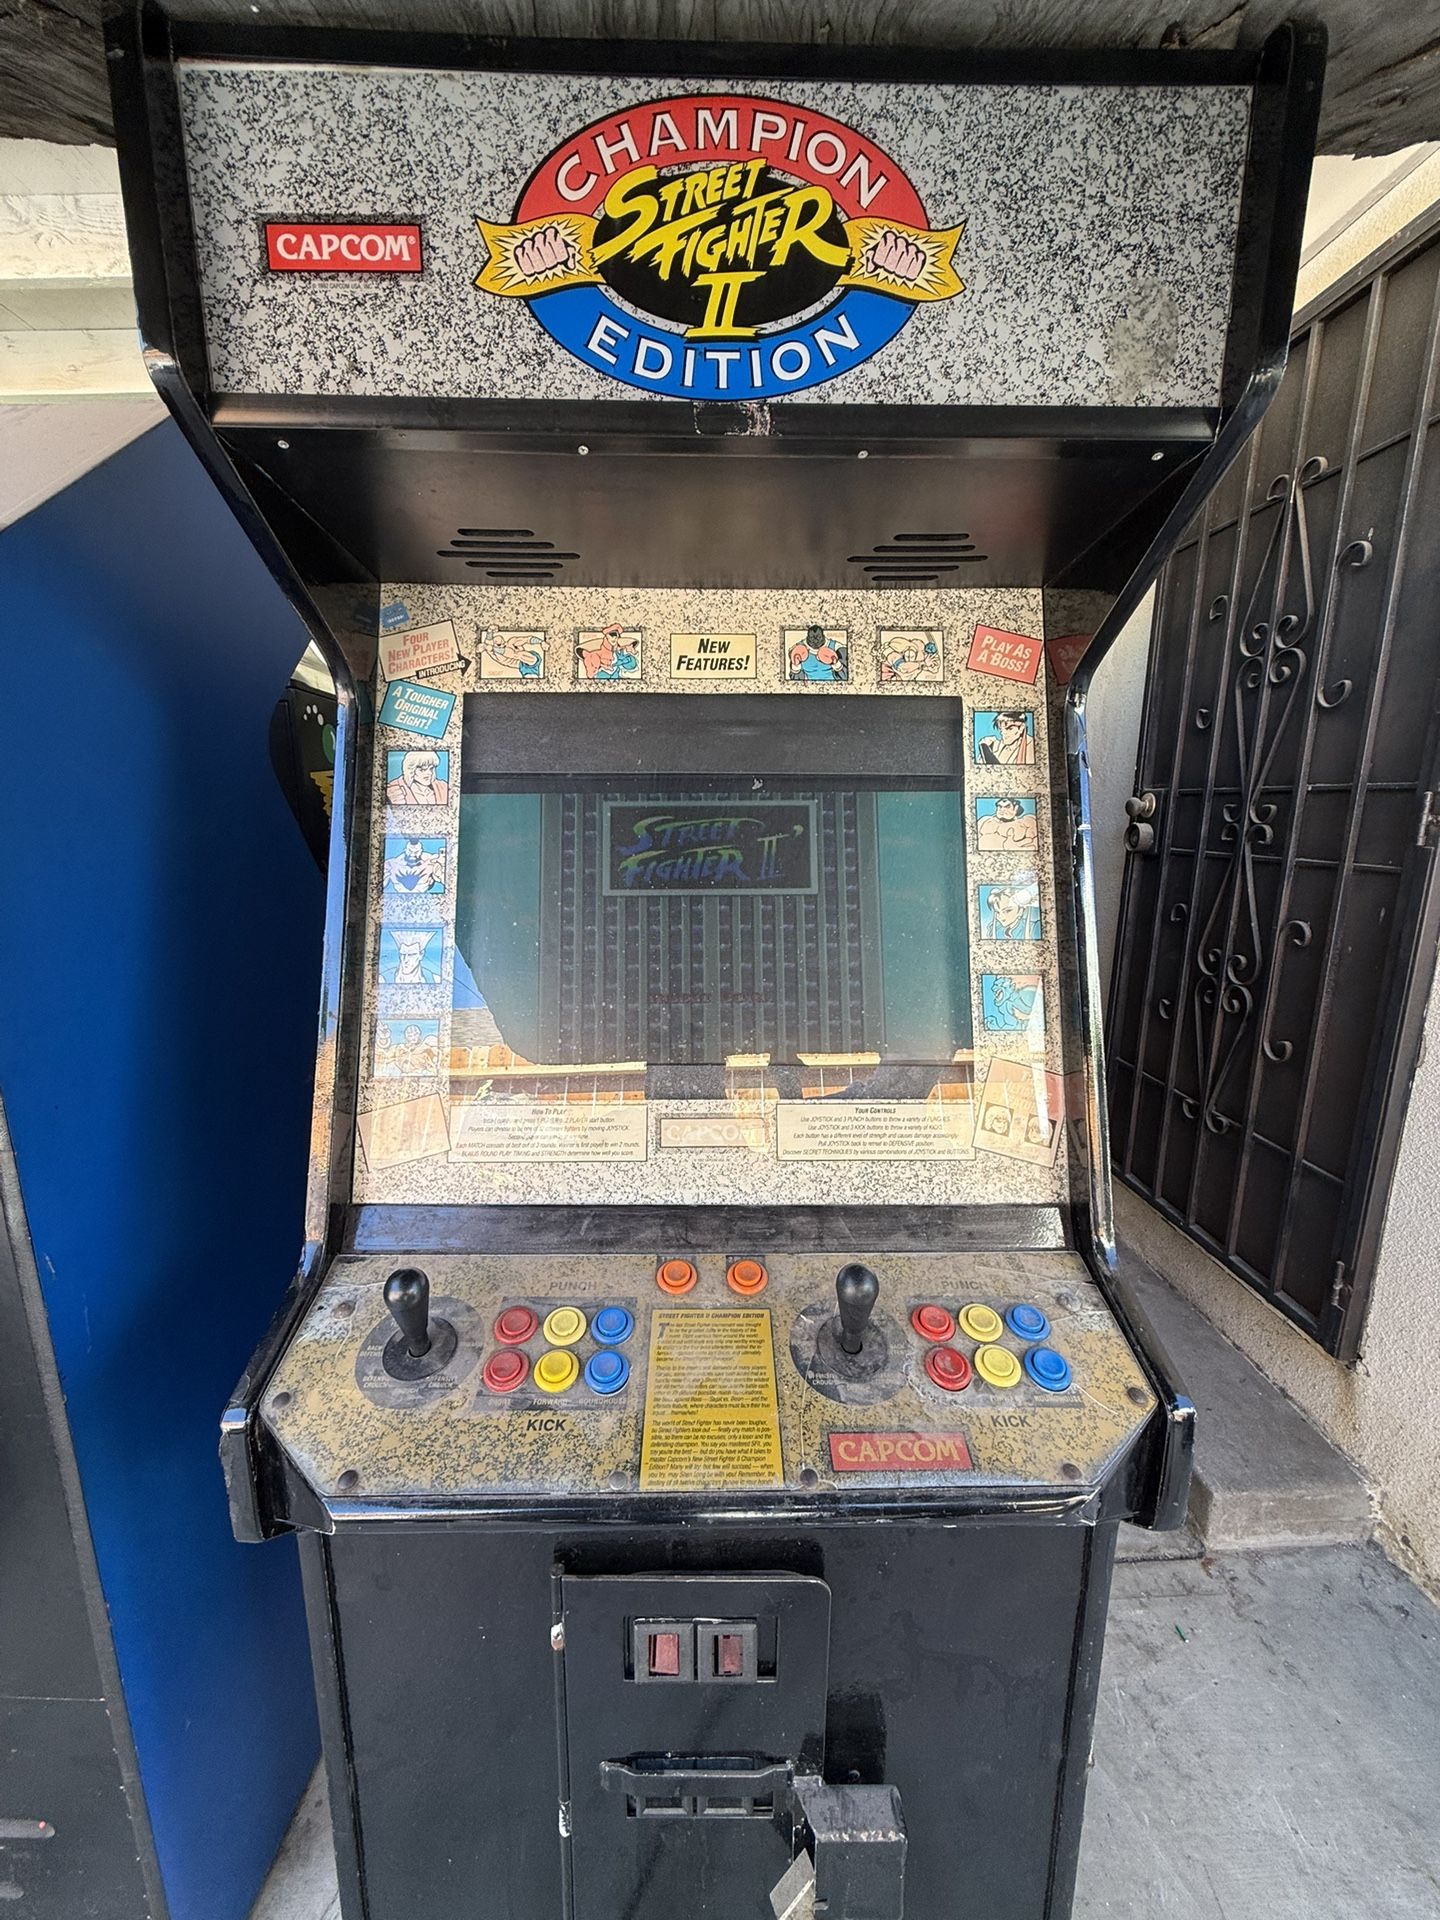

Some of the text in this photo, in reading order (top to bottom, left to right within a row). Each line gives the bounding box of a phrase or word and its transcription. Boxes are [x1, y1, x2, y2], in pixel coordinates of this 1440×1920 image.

[555, 108, 888, 208] CHAMPION
[590, 158, 767, 268] STREET
[627, 186, 852, 281] FIGHTER
[684, 271, 767, 337] II
[584, 313, 861, 390] EDITION
[388, 639, 449, 662] NEW PLAYER
[403, 632, 429, 646] FOUR
[698, 638, 731, 653] NEW
[981, 635, 1032, 659] PLAY AS
[388, 648, 454, 674] CHARACTERS!
[418, 660, 466, 679] INTRODUCING
[676, 655, 751, 671] FEATURES!
[976, 649, 1030, 673] A BOSS!
[392, 686, 450, 711] A TOUGHER
[394, 698, 440, 720] ORIGINAL
[396, 712, 433, 730] EIGHT!
[616, 815, 766, 855] STREET
[617, 844, 751, 888] FIGHTER
[526, 1418, 567, 1432] KICK
[991, 1415, 1032, 1429] KICK
